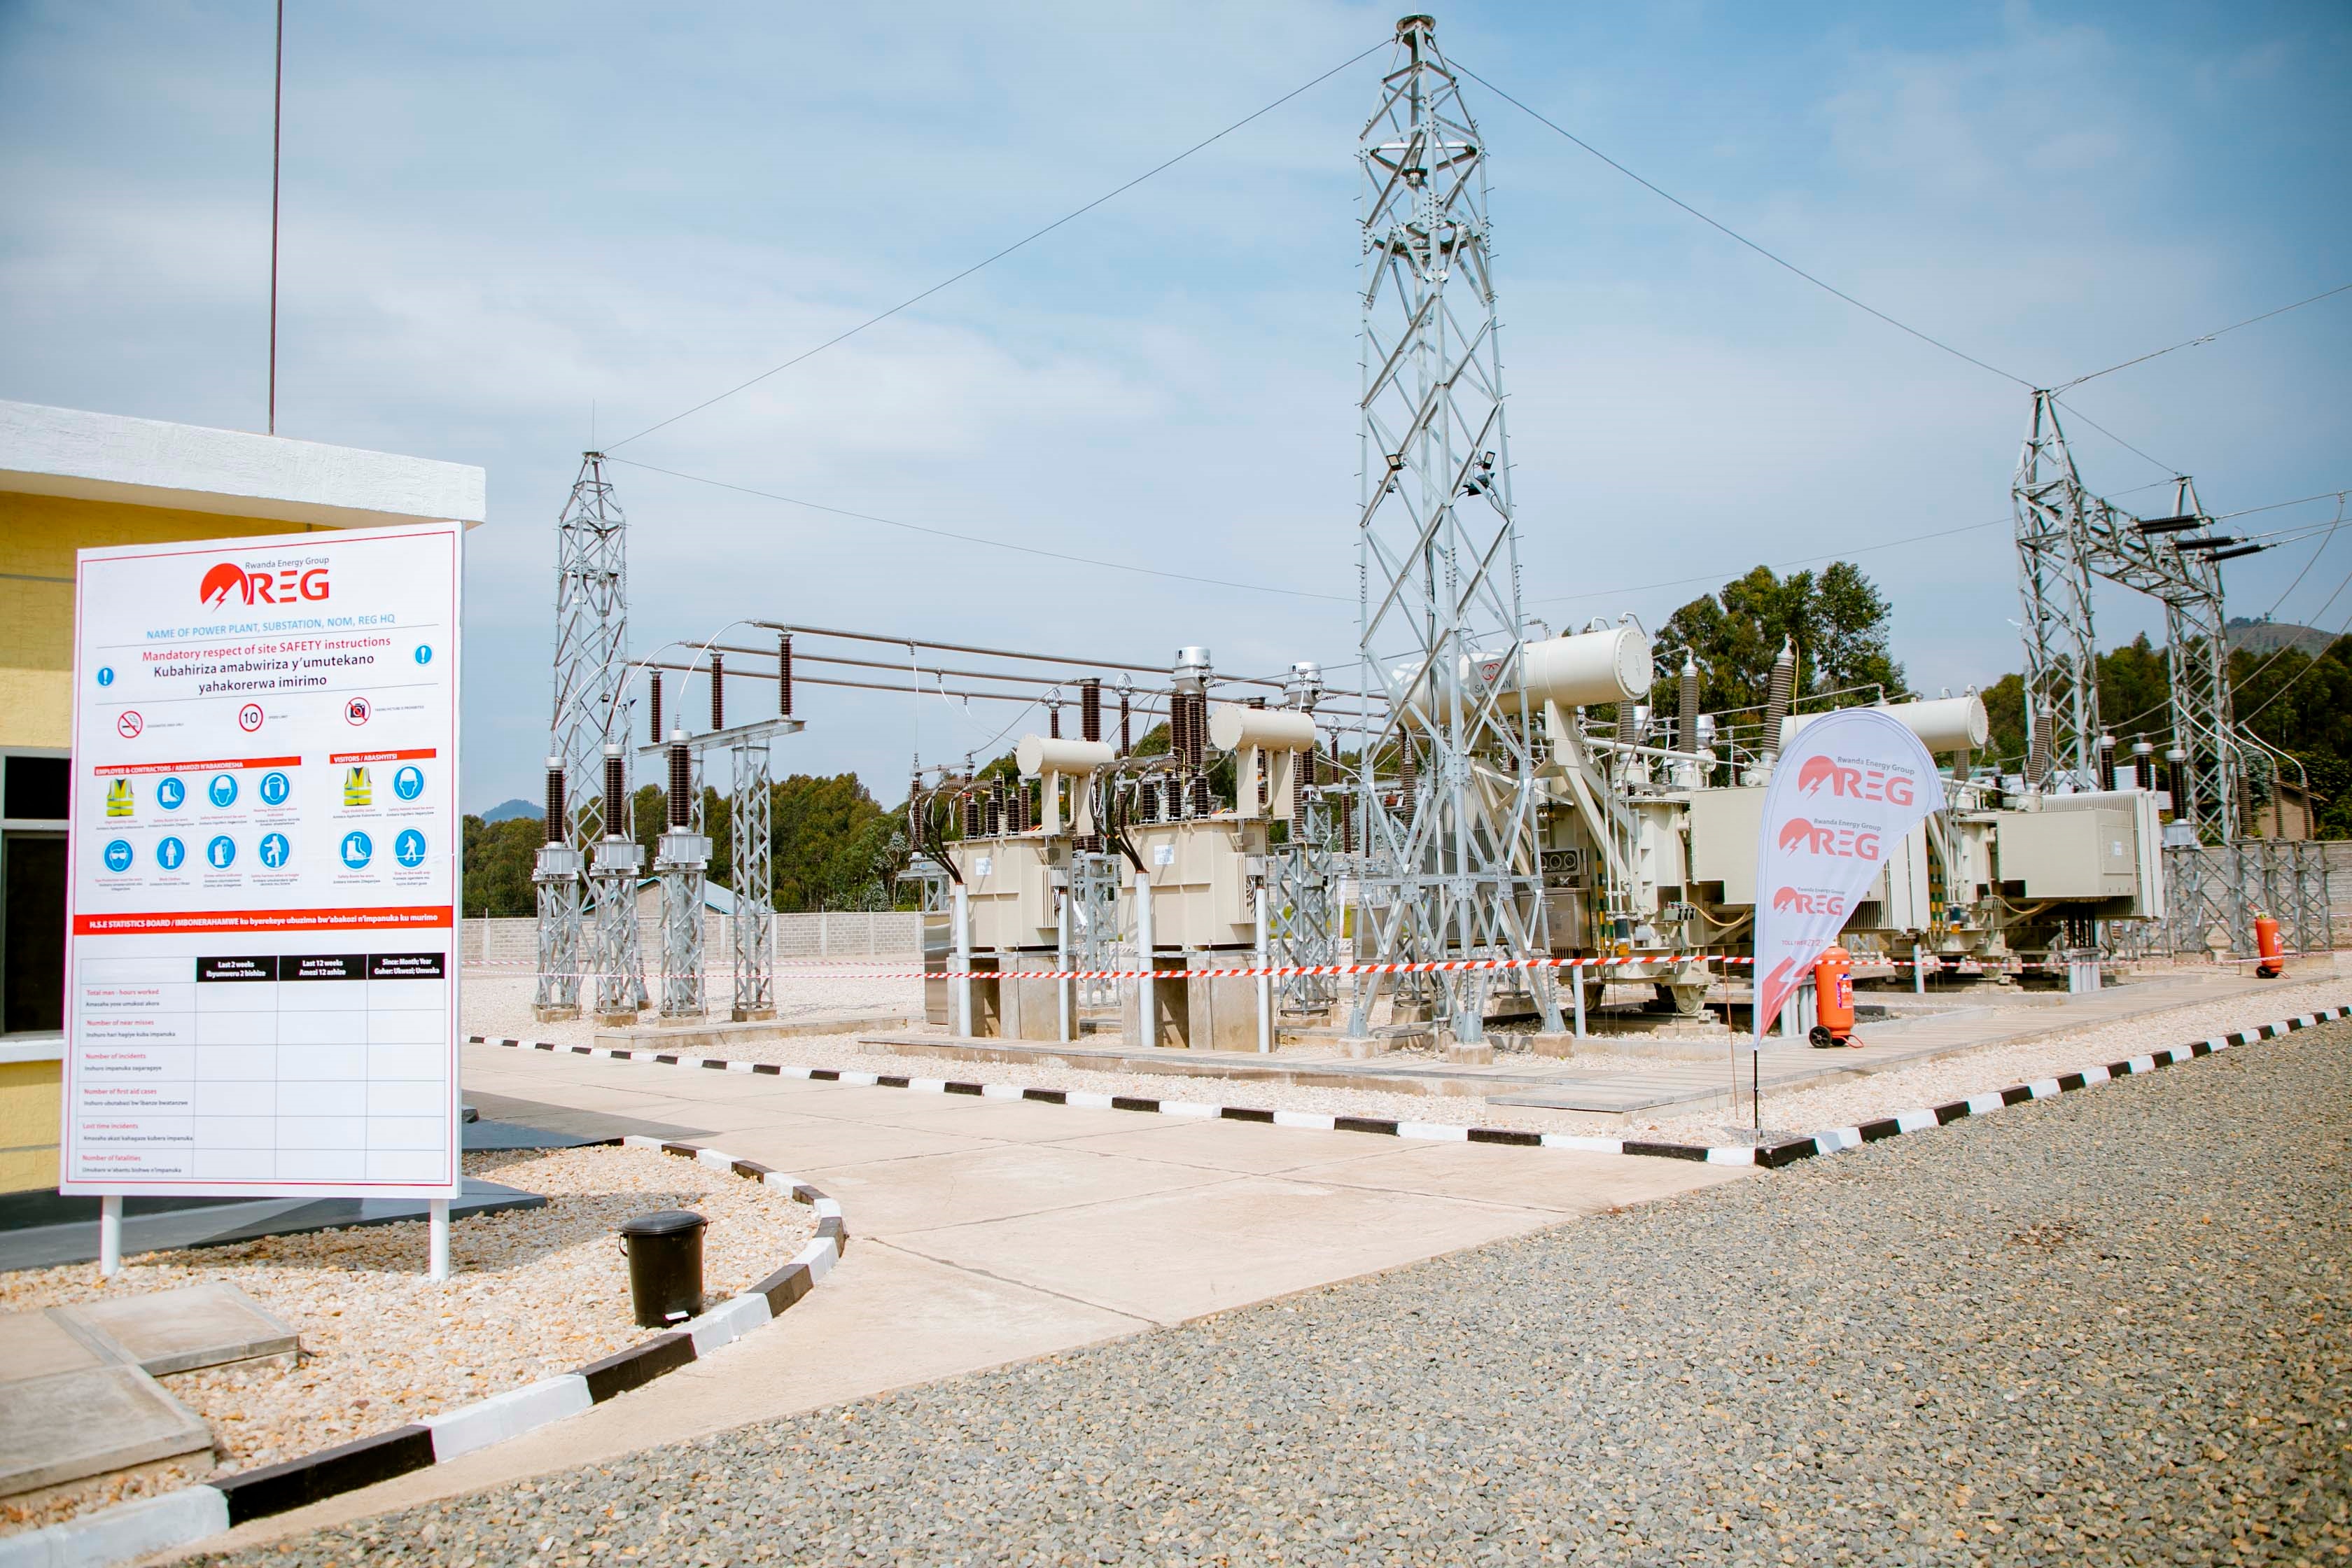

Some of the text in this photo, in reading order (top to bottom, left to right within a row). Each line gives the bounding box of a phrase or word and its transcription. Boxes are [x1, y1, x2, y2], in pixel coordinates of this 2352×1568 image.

[278, 559, 303, 568] Energy
[305, 556, 329, 566] Group
[246, 568, 329, 605] REG
[146, 613, 396, 639] NAME OF POWER PLANT, SUBSTATION, NOM, REG HQ
[142, 636, 391, 662] Mandatory respect of site SAFETY instructions
[154, 654, 374, 677] Kubahiriza amabwiriza y'umutekano
[199, 675, 327, 695] yahakorerwa imirimo
[244, 712, 258, 723] 10
[131, 765, 172, 774] CONTRACTORS
[1837, 756, 1915, 776] Rwanda Energy Group
[1835, 767, 1914, 806] REG
[1814, 818, 1882, 832] Rwanda Energy Group
[1812, 827, 1880, 861] REG
[1796, 894, 1845, 916] REG
[108, 919, 146, 928] STATISTICS
[146, 918, 172, 927] BOARD
[175, 917, 239, 927] IMBONERAHAMWE
[240, 917, 249, 925] ku
[250, 917, 286, 927] byerekeye
[286, 916, 317, 924] ubuzima
